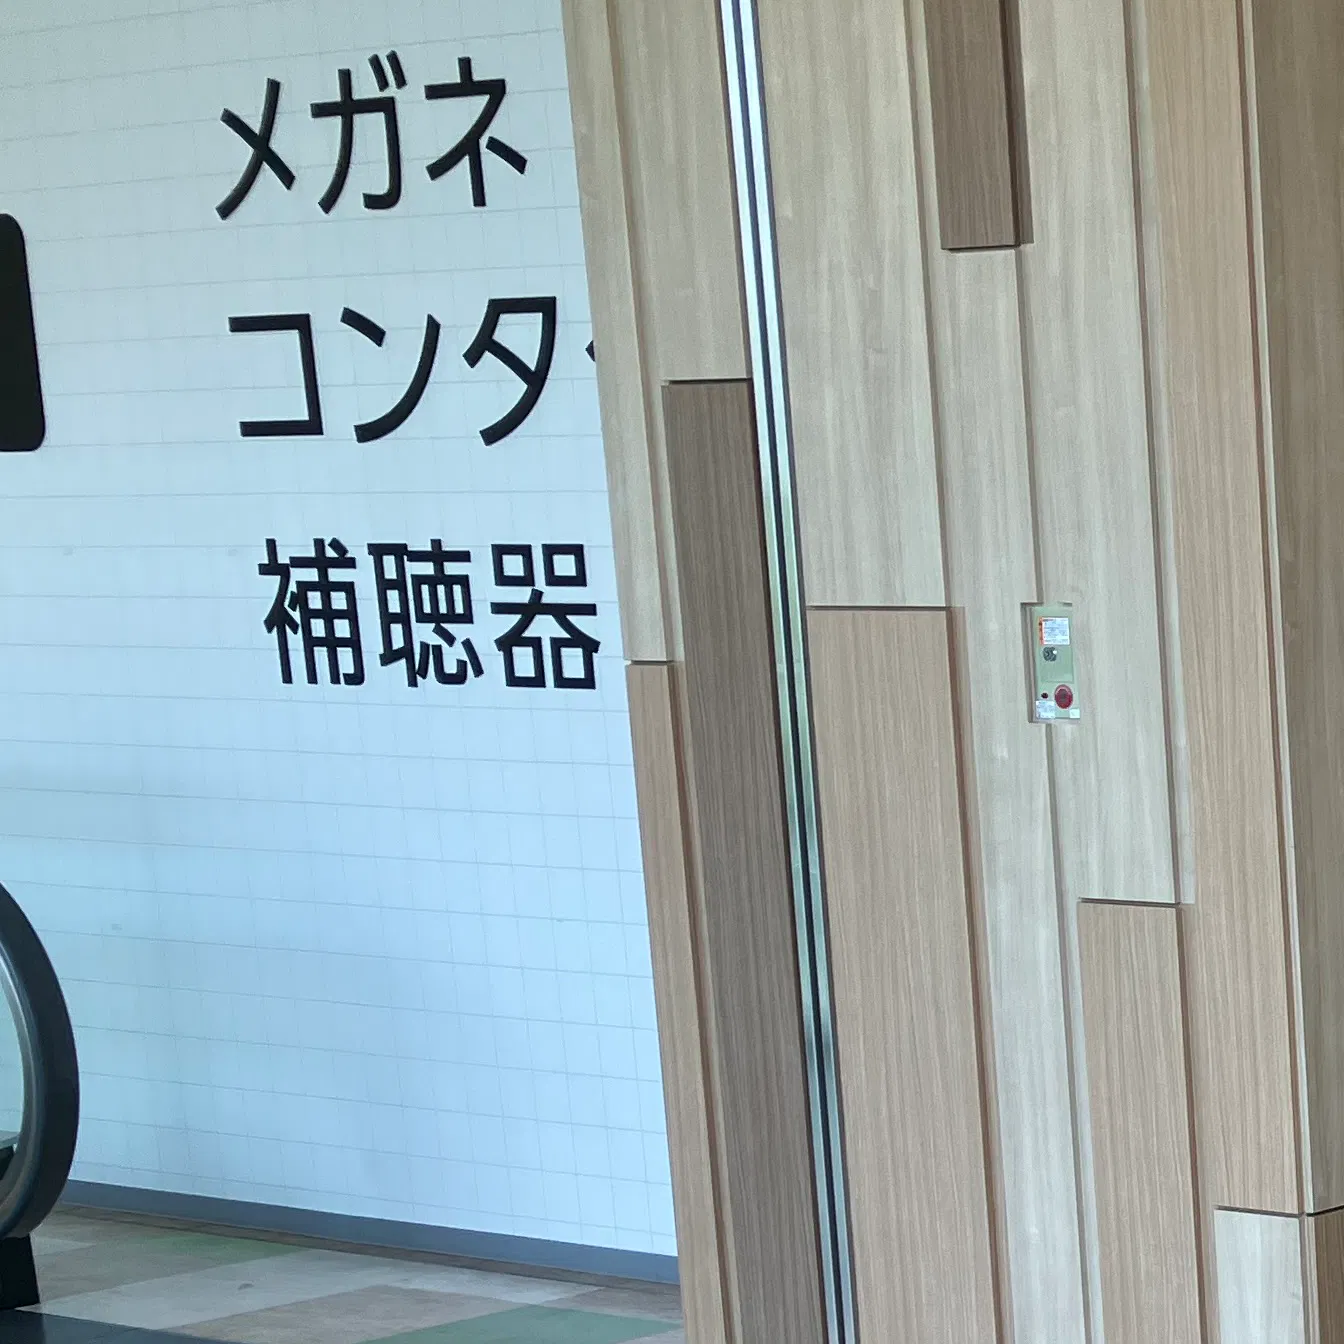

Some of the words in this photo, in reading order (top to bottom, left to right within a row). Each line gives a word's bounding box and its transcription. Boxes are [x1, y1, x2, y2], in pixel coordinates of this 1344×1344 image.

[215, 50, 528, 221] メガネ
[228, 296, 596, 446] コンタ
[258, 537, 600, 690] 補聴器
